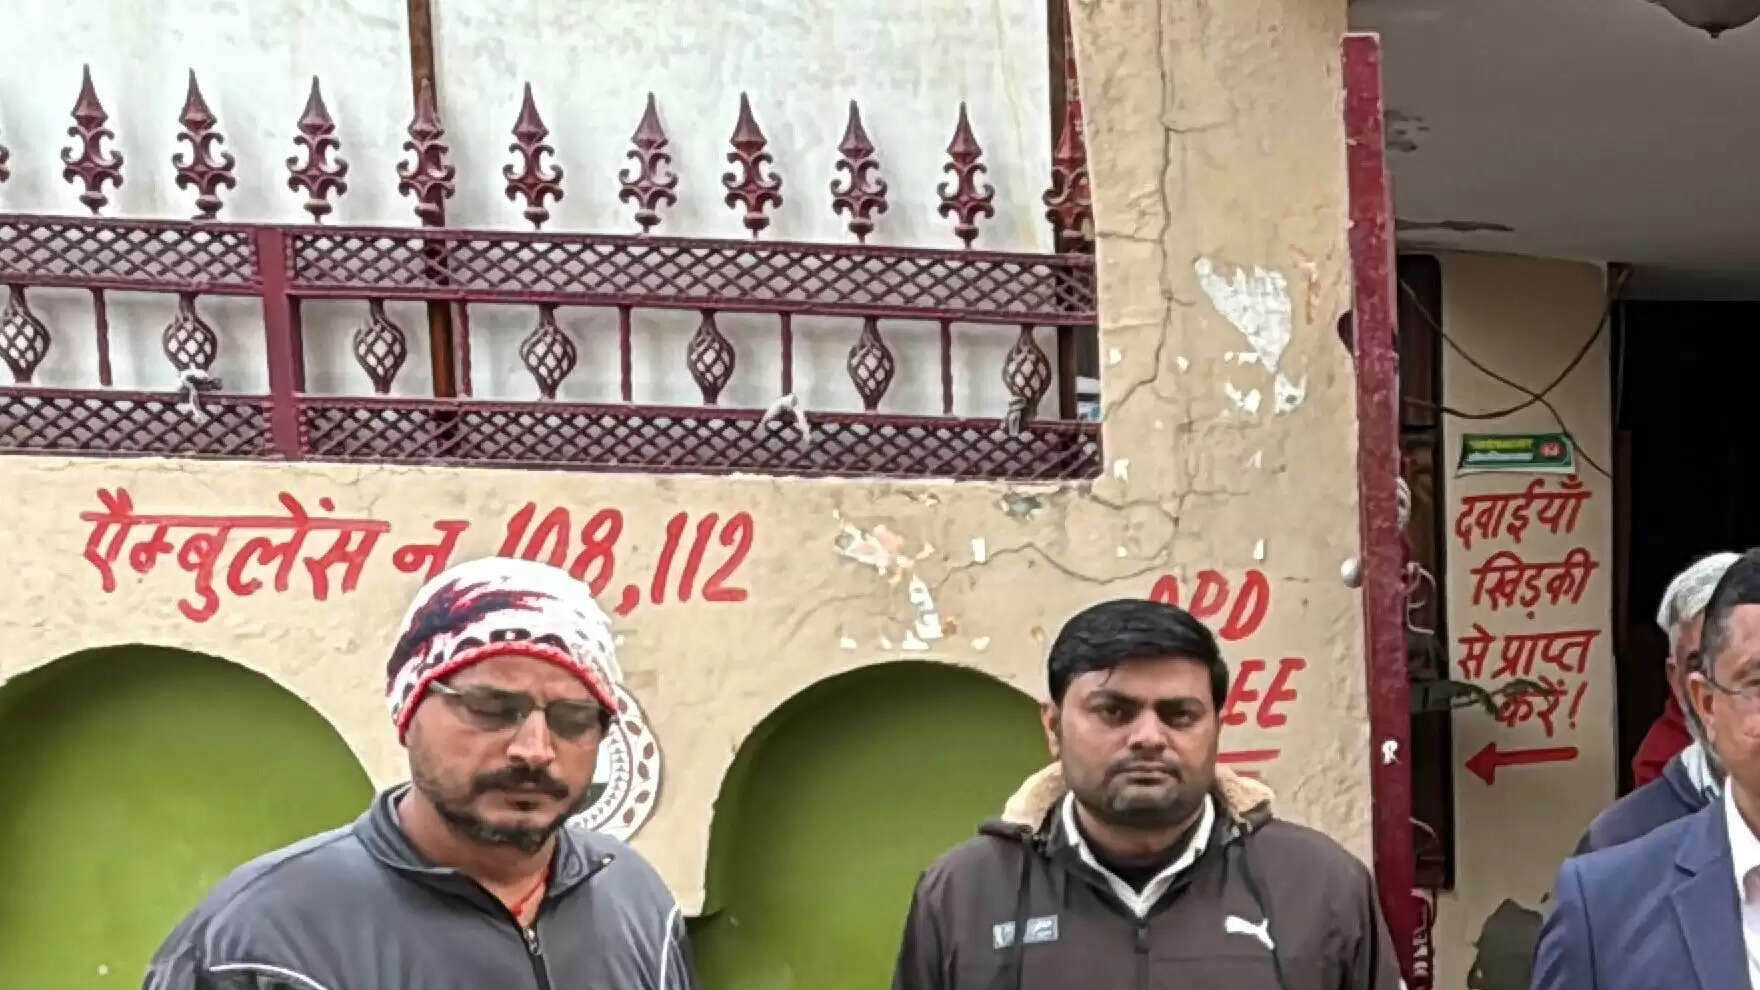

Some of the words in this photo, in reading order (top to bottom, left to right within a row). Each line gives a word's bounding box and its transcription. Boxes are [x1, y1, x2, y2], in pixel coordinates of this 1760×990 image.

[1470, 547, 1599, 620] खिड़की
[1458, 623, 1495, 680] से
[1491, 629, 1602, 680] प्राप्त
